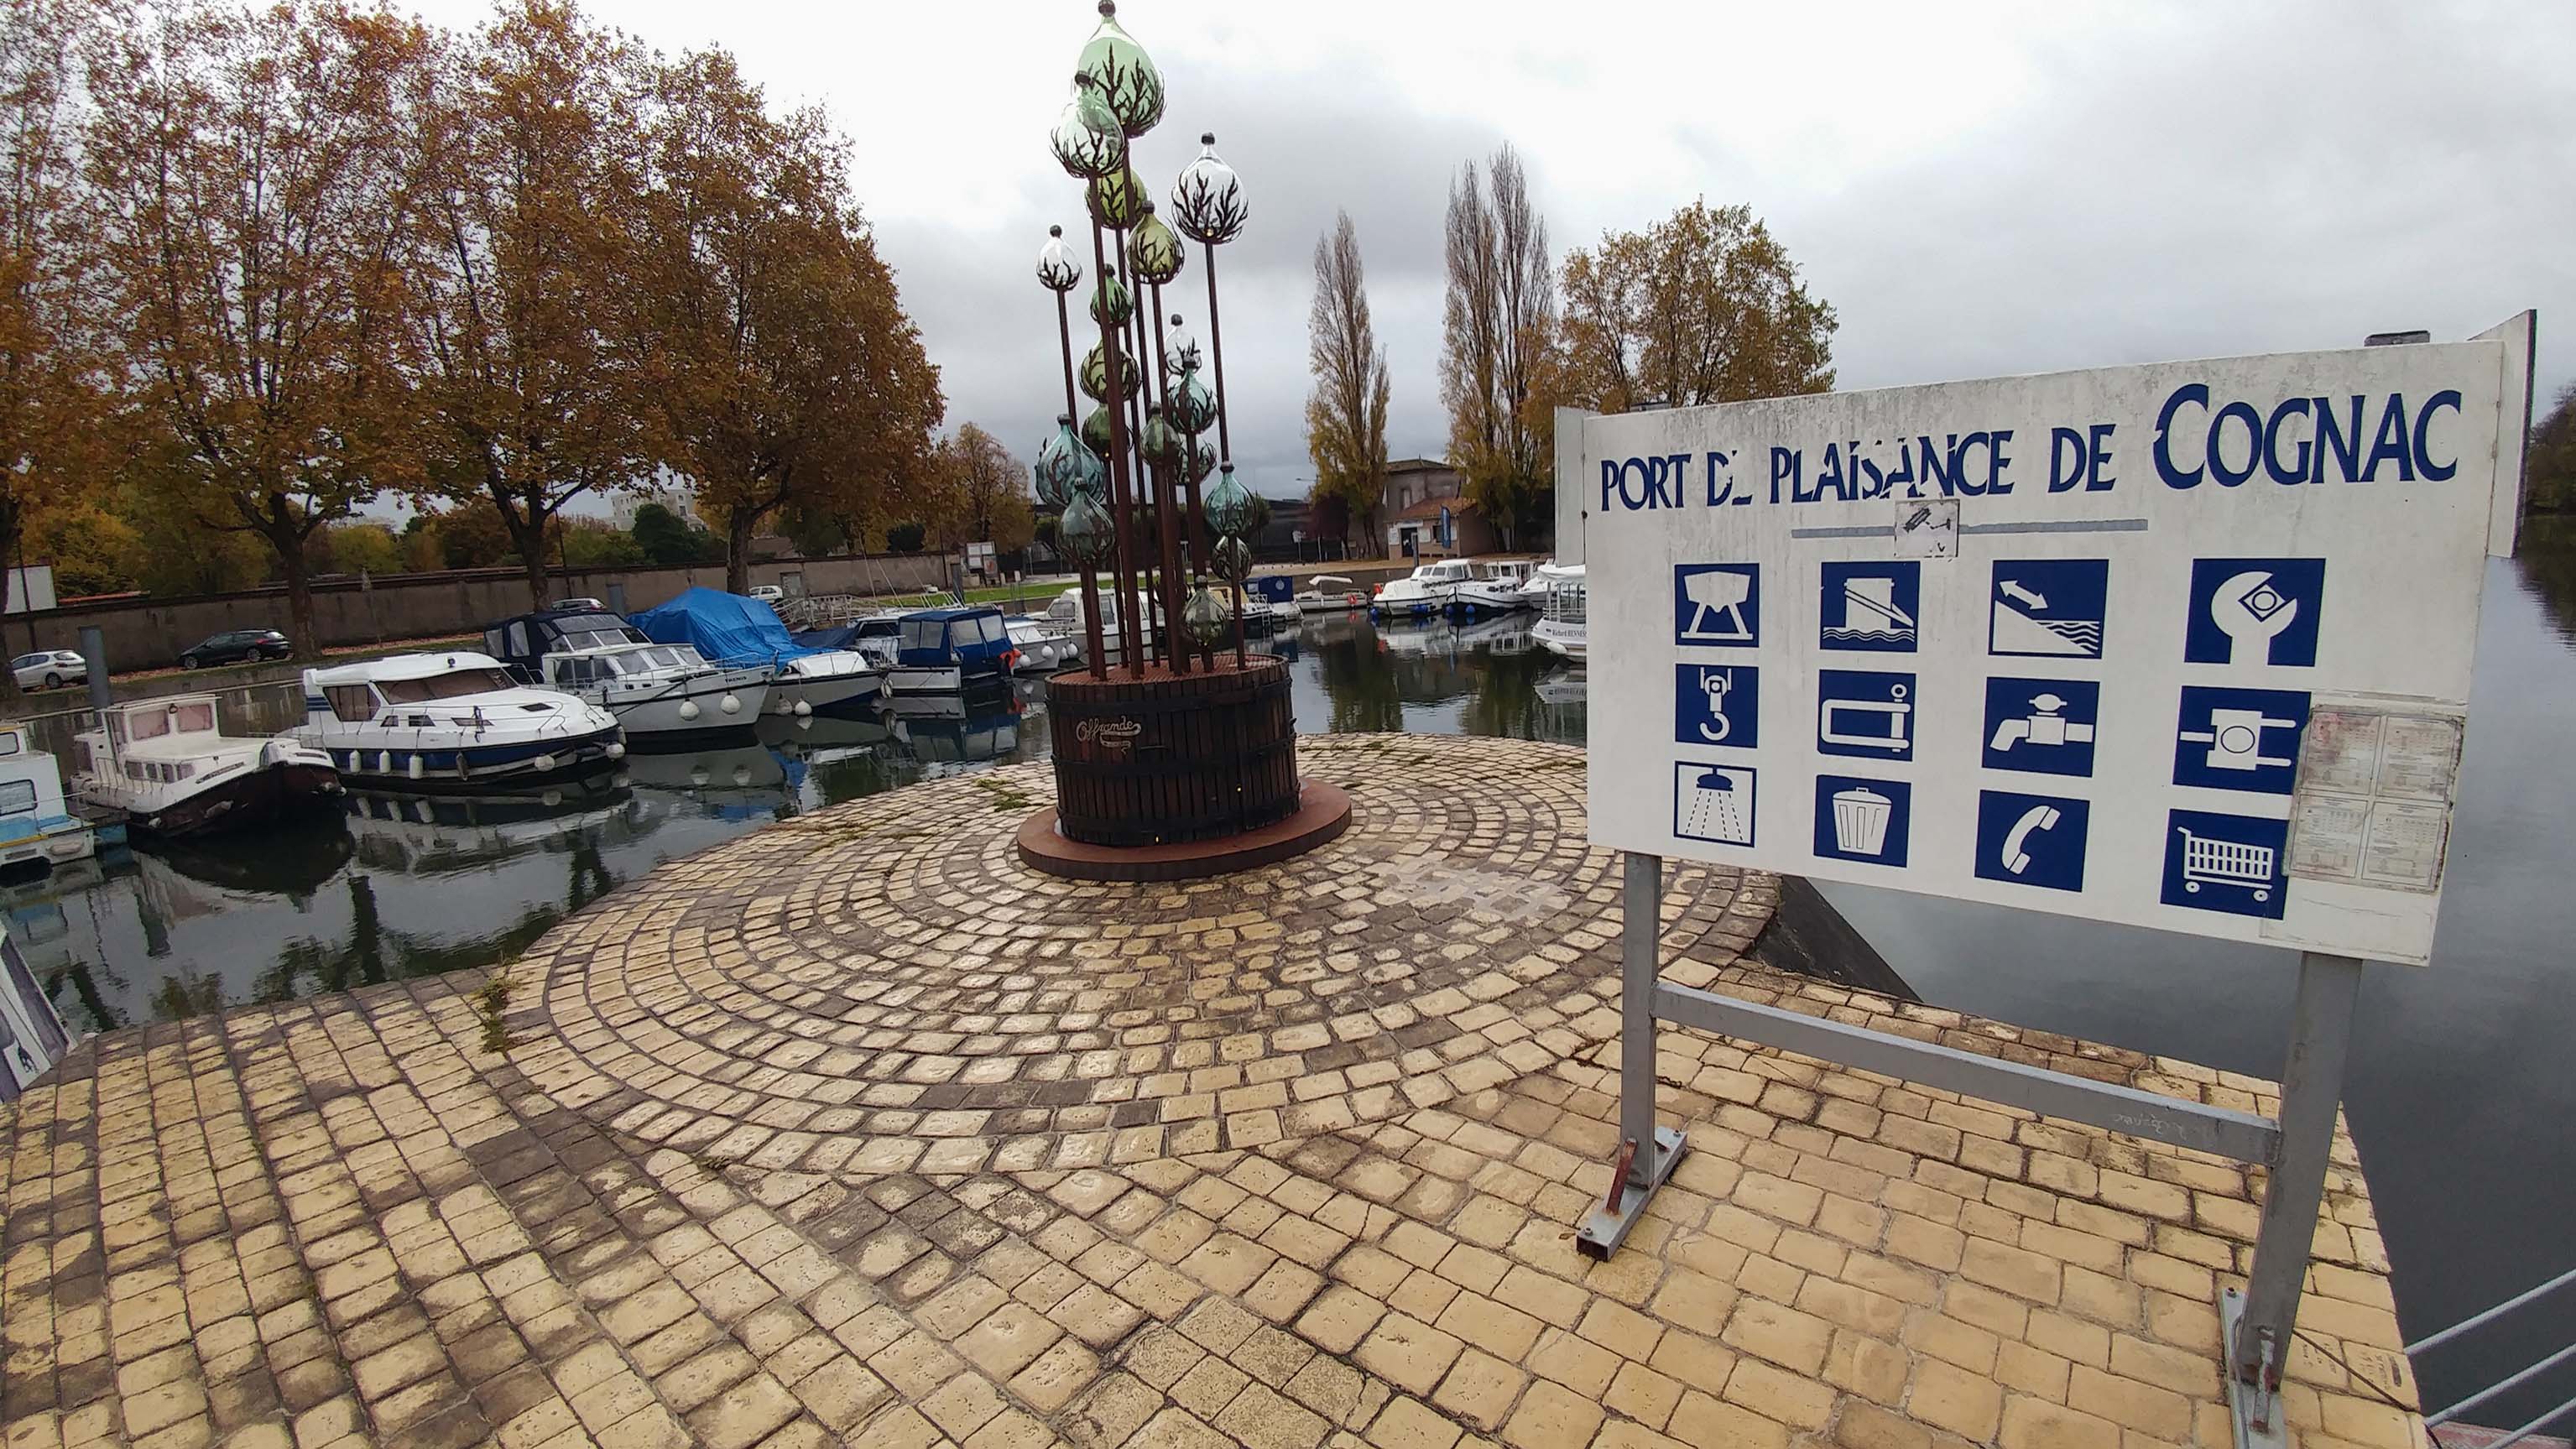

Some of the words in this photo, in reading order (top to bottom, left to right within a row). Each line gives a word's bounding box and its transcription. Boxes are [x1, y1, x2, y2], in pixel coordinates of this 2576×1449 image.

[1601, 452, 1692, 512] PORT
[2047, 424, 2116, 493] DE
[2153, 383, 2462, 490] COGNAC
[1076, 715, 1141, 742] Offrande
